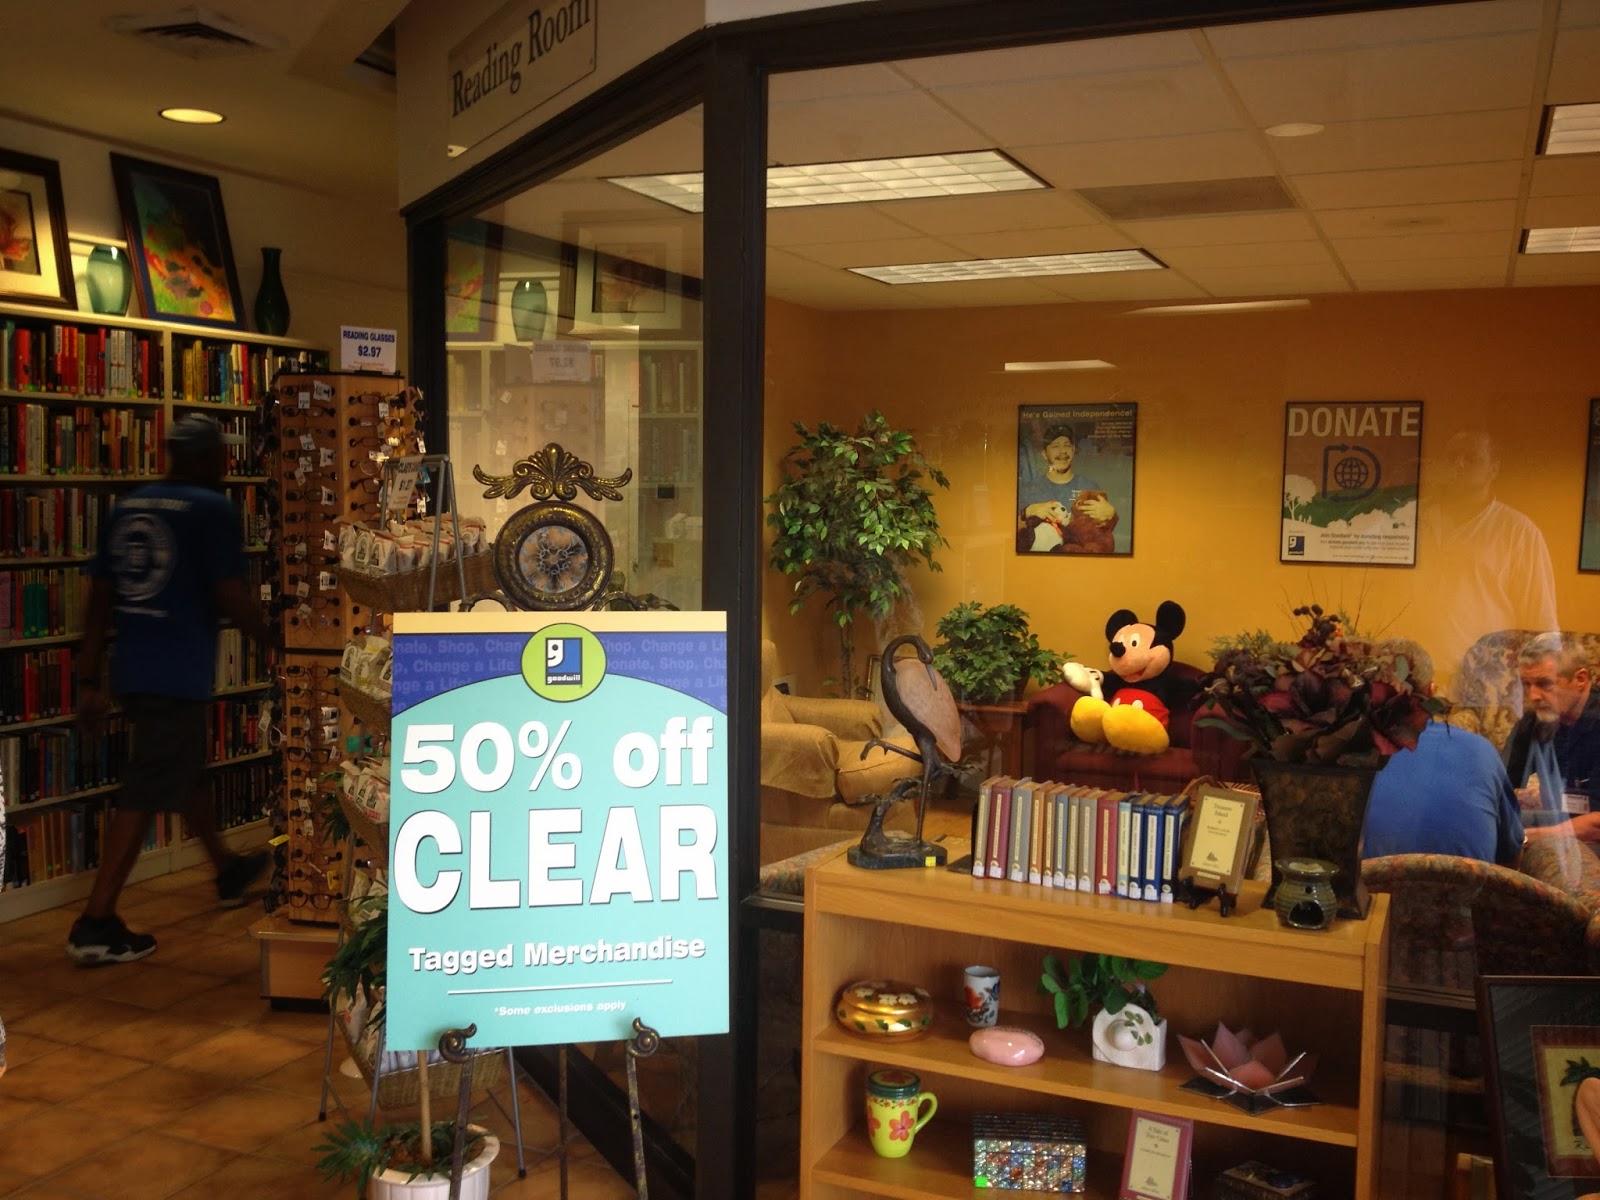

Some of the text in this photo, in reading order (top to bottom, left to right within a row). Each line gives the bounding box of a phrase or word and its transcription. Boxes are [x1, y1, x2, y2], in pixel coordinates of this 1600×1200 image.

[452, 0, 591, 118] Reading Room
[343, 330, 395, 343] READING GLASSES
[357, 345, 382, 359] $2.97
[1022, 411, 1041, 419] He's
[1043, 410, 1071, 418] Gained
[1288, 407, 1420, 437] DONATE
[438, 639, 479, 655] Shop,
[485, 638, 523, 653] Chan
[641, 638, 694, 655] Change
[413, 659, 470, 675] Change
[489, 658, 514, 672] Life
[547, 675, 581, 684] goodwill
[400, 716, 714, 795] 50% off
[393, 804, 719, 915] CLEAR
[408, 935, 706, 975] Tagged Merchandise
[534, 1003, 594, 1015] exclusions
[596, 1000, 627, 1013] apply
